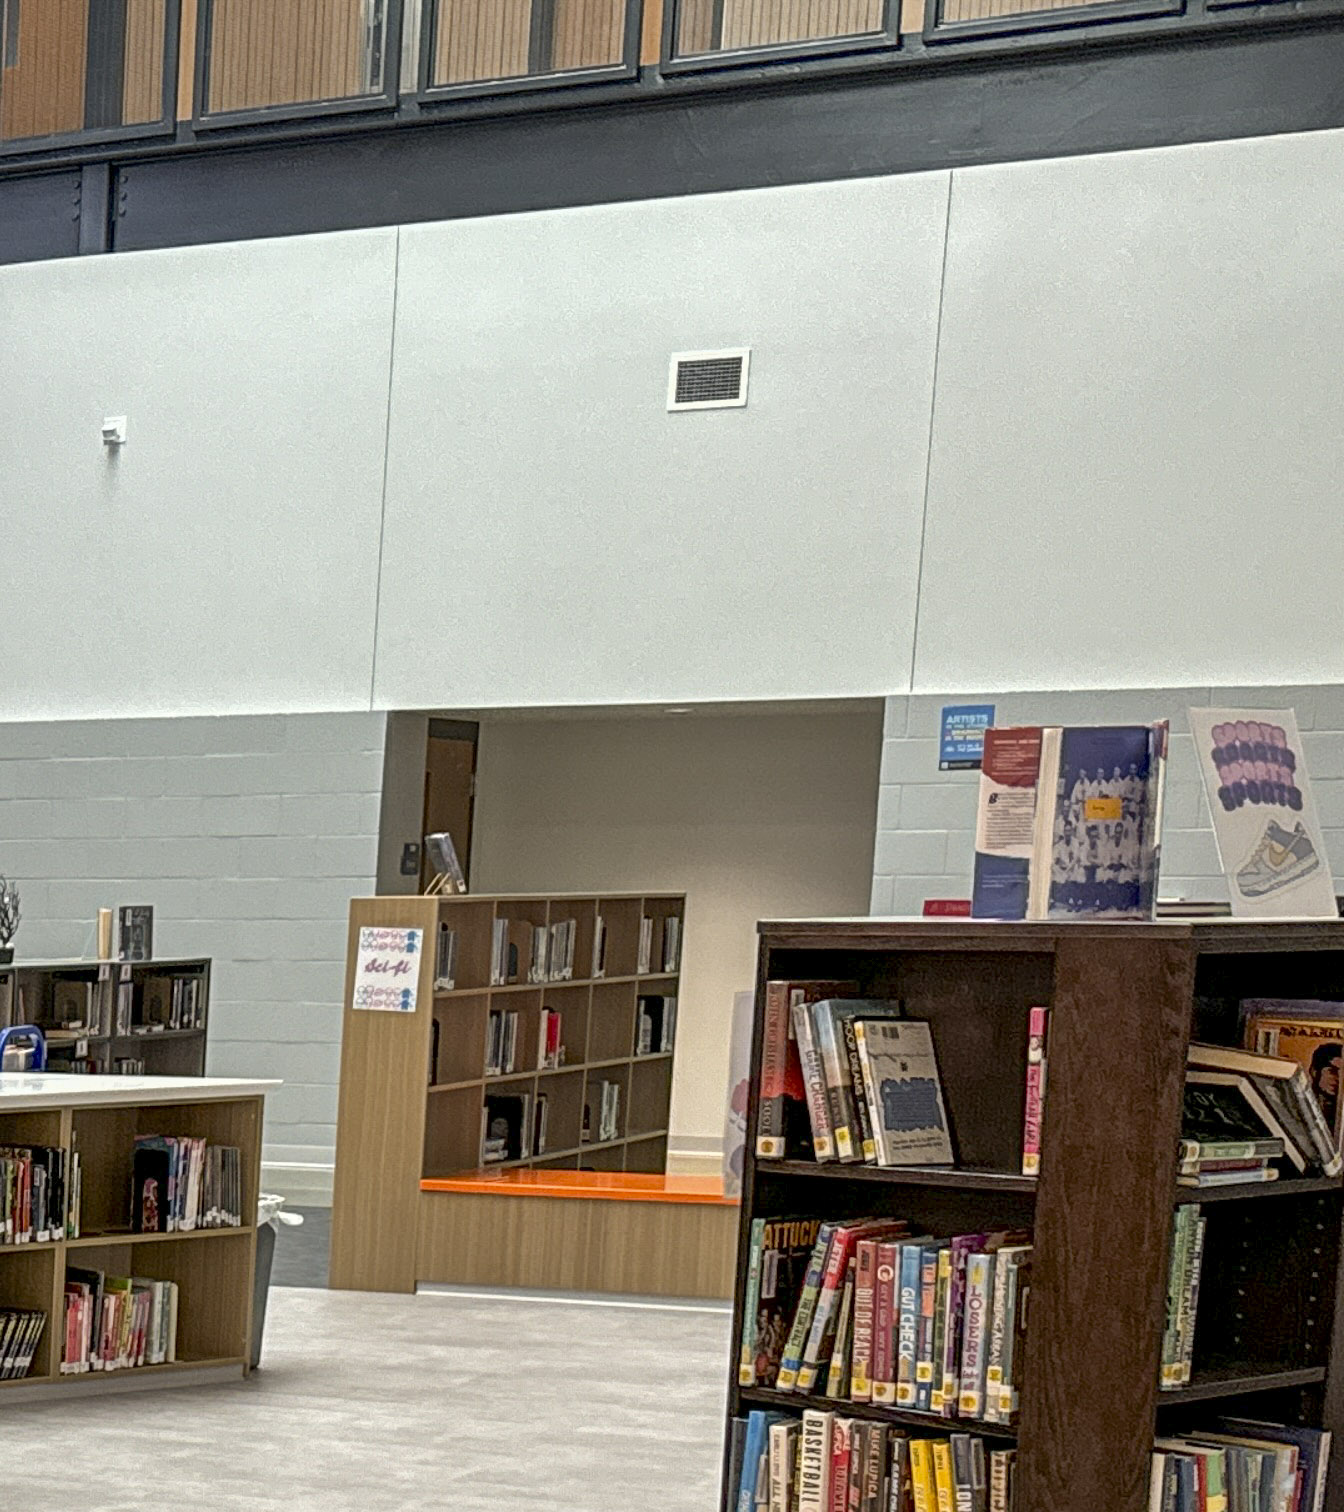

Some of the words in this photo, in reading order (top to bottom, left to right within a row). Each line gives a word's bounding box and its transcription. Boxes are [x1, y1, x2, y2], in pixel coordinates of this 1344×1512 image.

[946, 714, 989, 724] ARTISTS
[841, 1018, 857, 1051] HOOP
[848, 1053, 864, 1097] DREAMS
[764, 1219, 821, 1250] ATTUCK
[855, 1287, 874, 1309] OUT
[900, 1286, 916, 1309] GUT
[855, 1310, 873, 1325] OF
[965, 1285, 984, 1368] LOSERS
[898, 1312, 915, 1360] CHECK
[872, 1429, 882, 1456] MIKE
[800, 1419, 824, 1504] BASKETBALL
[771, 1479, 783, 1499] ALL
[867, 1458, 882, 1499] LUPICA
